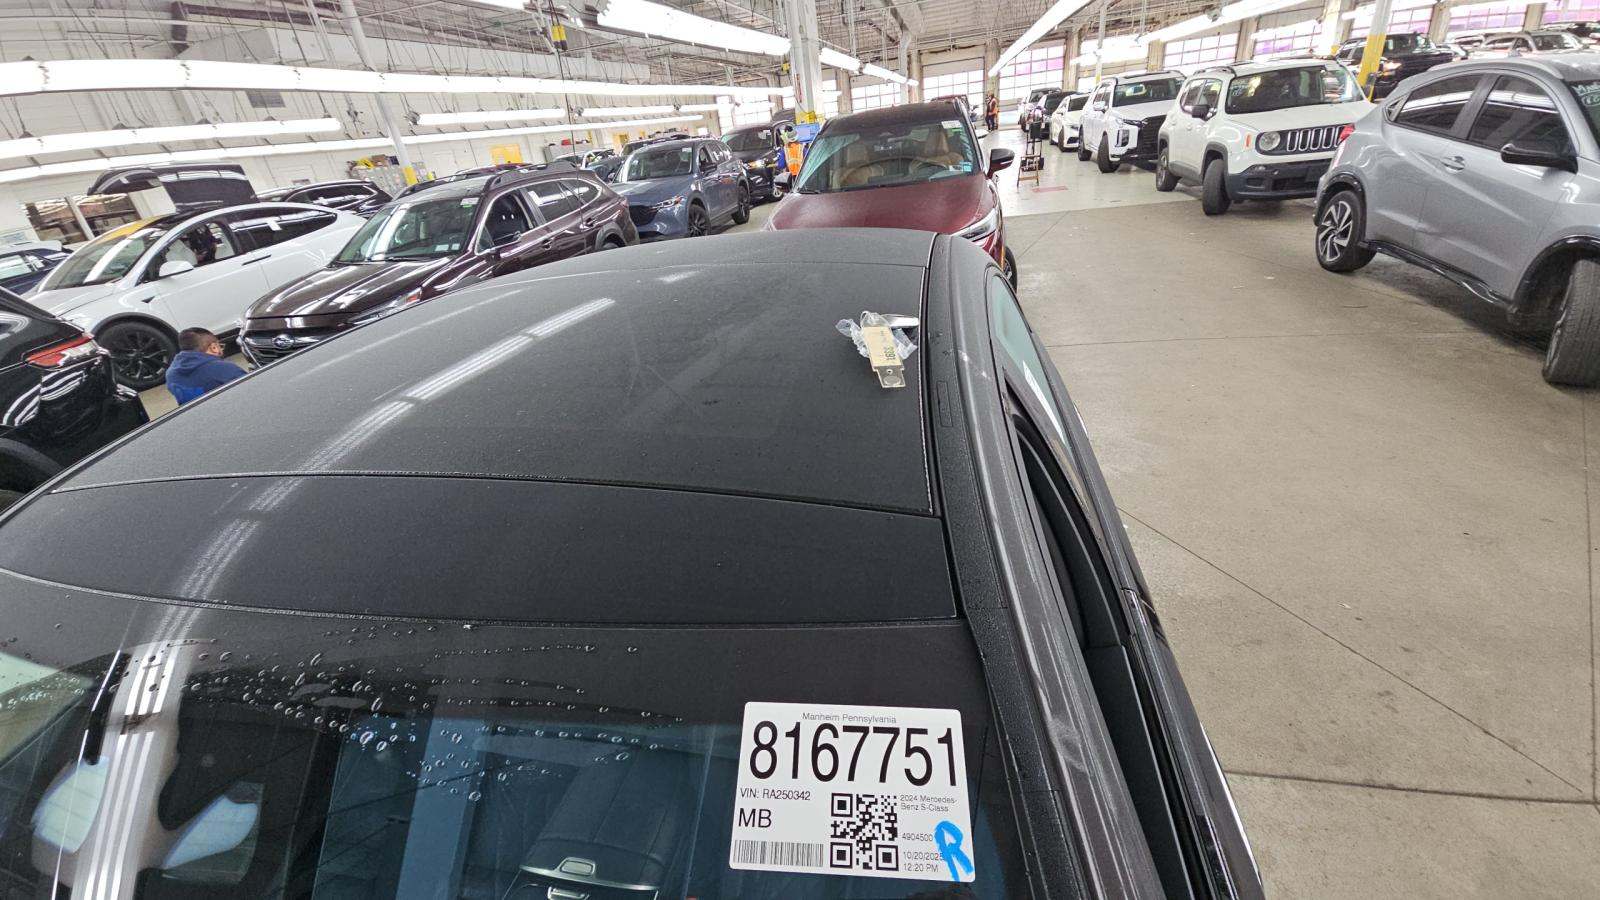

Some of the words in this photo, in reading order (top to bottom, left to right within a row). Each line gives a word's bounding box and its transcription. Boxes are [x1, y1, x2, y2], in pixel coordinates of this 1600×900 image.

[802, 712, 840, 721] Manheim
[842, 713, 897, 724] Pennsylvania
[750, 720, 957, 787] 8167751
[740, 788, 760, 798] VIN:
[763, 788, 811, 801] RA250342
[900, 794, 918, 802] 2024
[900, 802, 919, 811] Benz
[921, 803, 949, 812] S-Class
[738, 807, 772, 828] MB
[902, 832, 934, 842] 4904500
[934, 820, 974, 883] R
[903, 863, 924, 872] 12:20
[926, 863, 938, 872] PM
